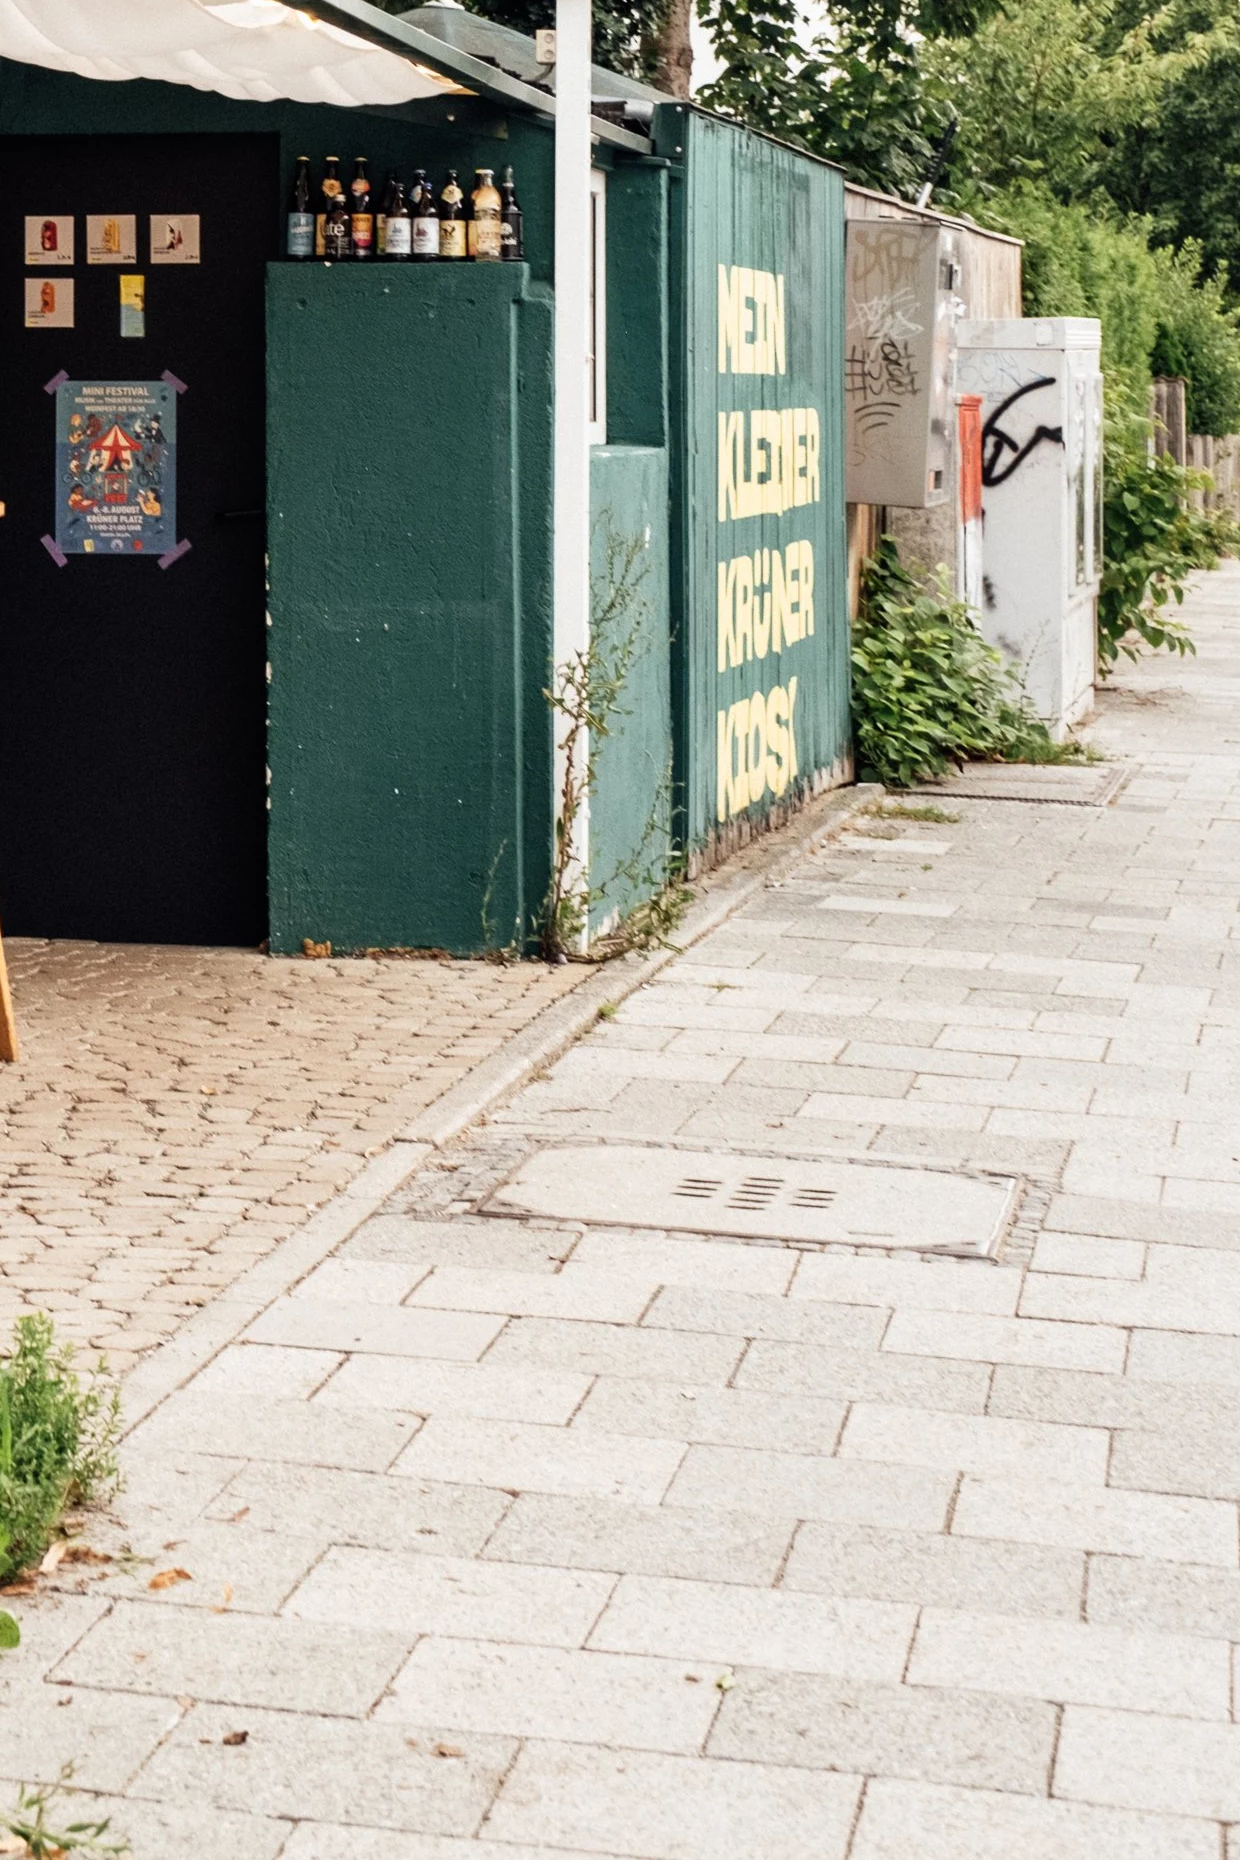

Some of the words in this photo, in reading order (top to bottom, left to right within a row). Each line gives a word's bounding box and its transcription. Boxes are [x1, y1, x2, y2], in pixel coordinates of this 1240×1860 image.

[718, 263, 786, 375] MEIN
[82, 386, 104, 396] MINI
[106, 386, 149, 396] FESTIVAL
[86, 513, 118, 523] KRÜNER
[120, 515, 144, 524] PLATZ
[112, 506, 140, 514] AUGUST
[718, 407, 820, 522] KLEINER
[717, 539, 816, 673] KRÜNER
[717, 675, 799, 823] KIOSK
